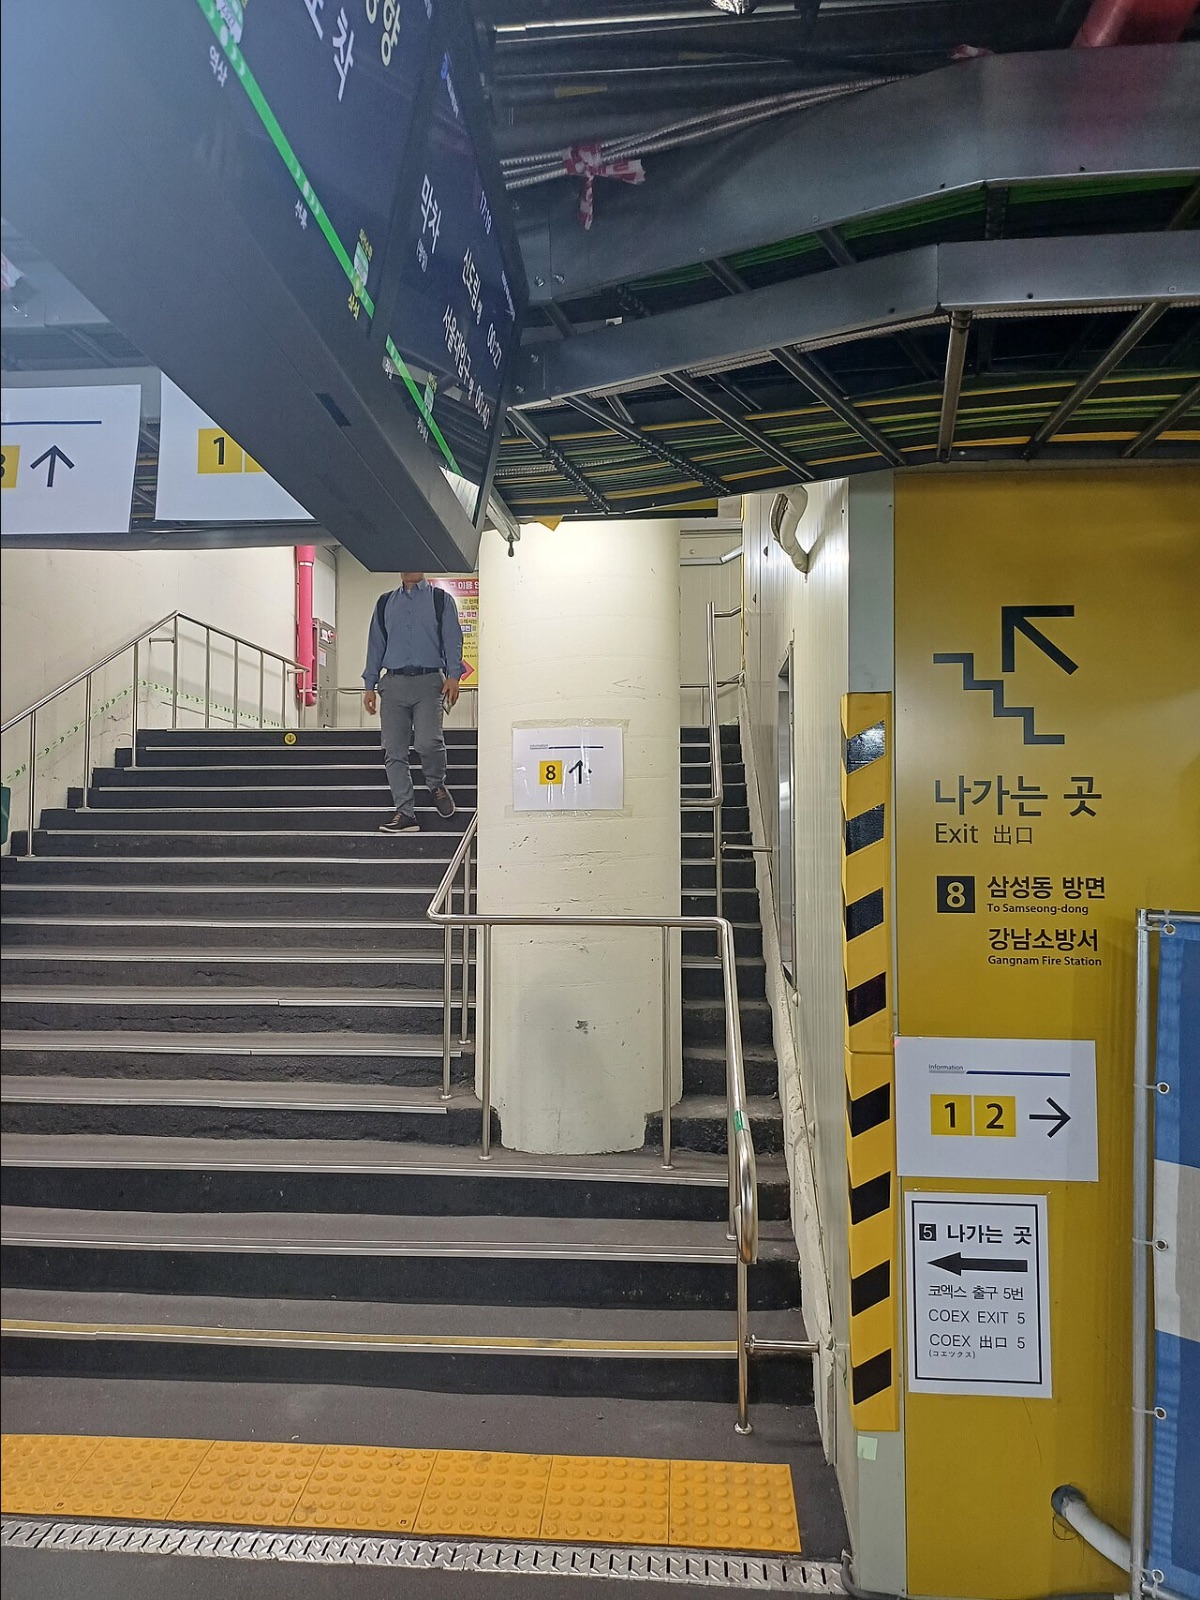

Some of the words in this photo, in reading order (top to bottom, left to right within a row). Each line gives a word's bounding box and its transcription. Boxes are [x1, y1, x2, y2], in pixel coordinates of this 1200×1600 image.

[209, 45, 228, 88] 역삼
[421, 174, 442, 254] 막차
[480, 190, 492, 235] 17:19
[475, 385, 490, 430] 00:40
[213, 436, 226, 466] 1
[545, 764, 556, 781] 8
[934, 775, 1049, 817] 나가는
[1063, 776, 1103, 817] 곳
[934, 822, 979, 844] Exit
[992, 824, 1034, 845] 出口
[946, 882, 966, 907] 8
[987, 876, 1053, 900] 삼성동
[1062, 876, 1106, 900] 방면
[987, 903, 1001, 914] To
[1002, 903, 1089, 916] Samseong-dong
[988, 928, 1099, 952] 강남소방서
[988, 956, 1040, 968] Gangnam
[1042, 955, 1062, 966] Fire
[1064, 955, 1102, 966] Station
[928, 1063, 964, 1071] Information
[944, 1102, 956, 1128] 1
[985, 1102, 1004, 1129] 2
[922, 1226, 933, 1240] 5
[947, 1224, 1003, 1244] 나가는
[1013, 1226, 1032, 1245] 곳
[928, 1284, 967, 1298] 코엑스
[972, 1285, 998, 1300] 출구
[1003, 1286, 1024, 1301] 5번
[928, 1309, 970, 1323] COEX
[977, 1310, 1009, 1324] EXIT
[1017, 1312, 1026, 1325] 5
[929, 1333, 971, 1347] COEX
[979, 1334, 1007, 1349] 出口
[1017, 1336, 1026, 1349] 5
